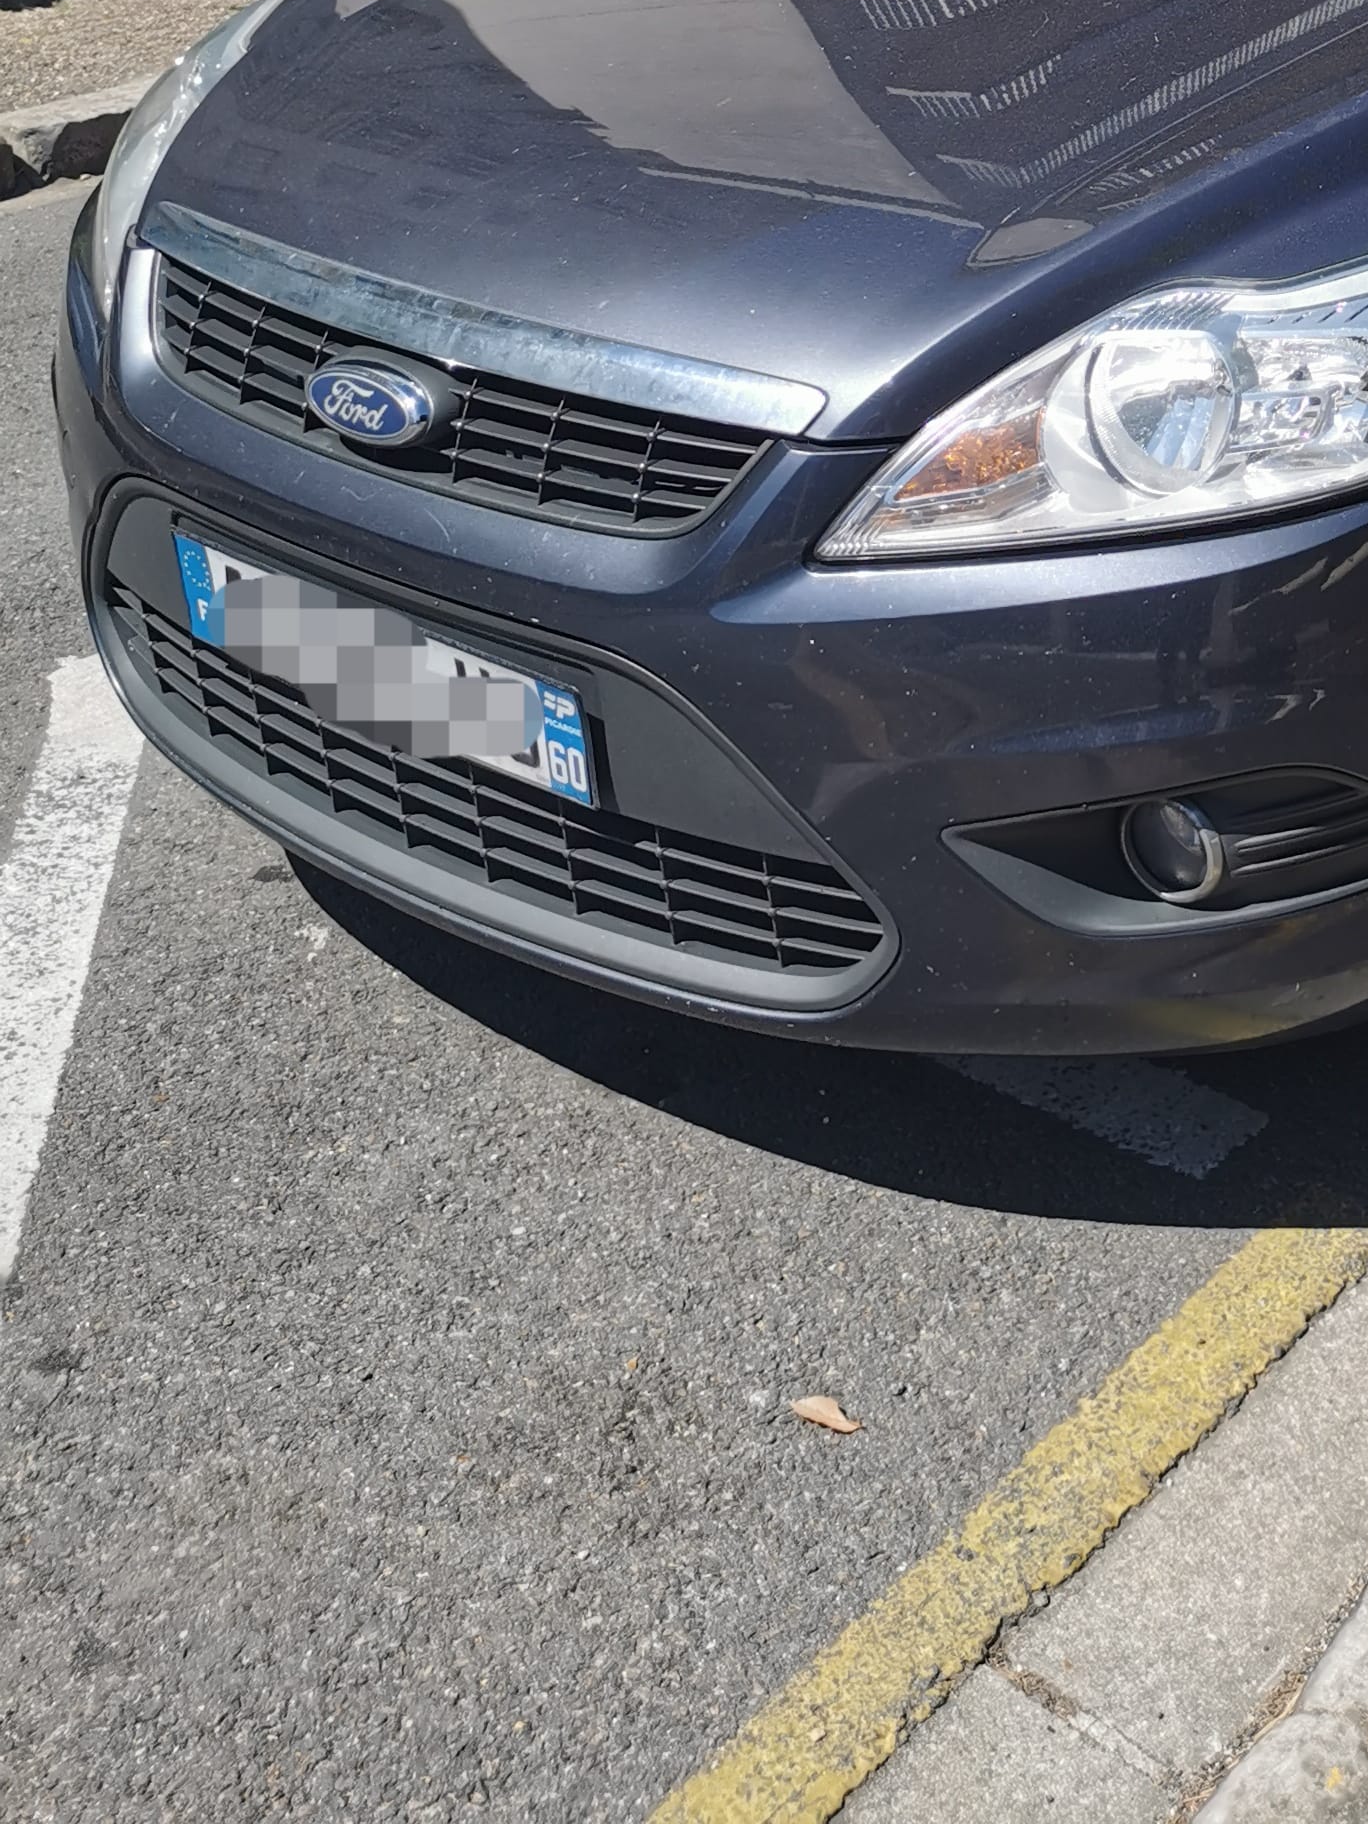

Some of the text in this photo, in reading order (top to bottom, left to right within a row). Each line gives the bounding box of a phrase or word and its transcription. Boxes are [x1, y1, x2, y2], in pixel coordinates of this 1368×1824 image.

[324, 378, 389, 431] Ford
[197, 597, 209, 622] F
[548, 739, 588, 793] 60
